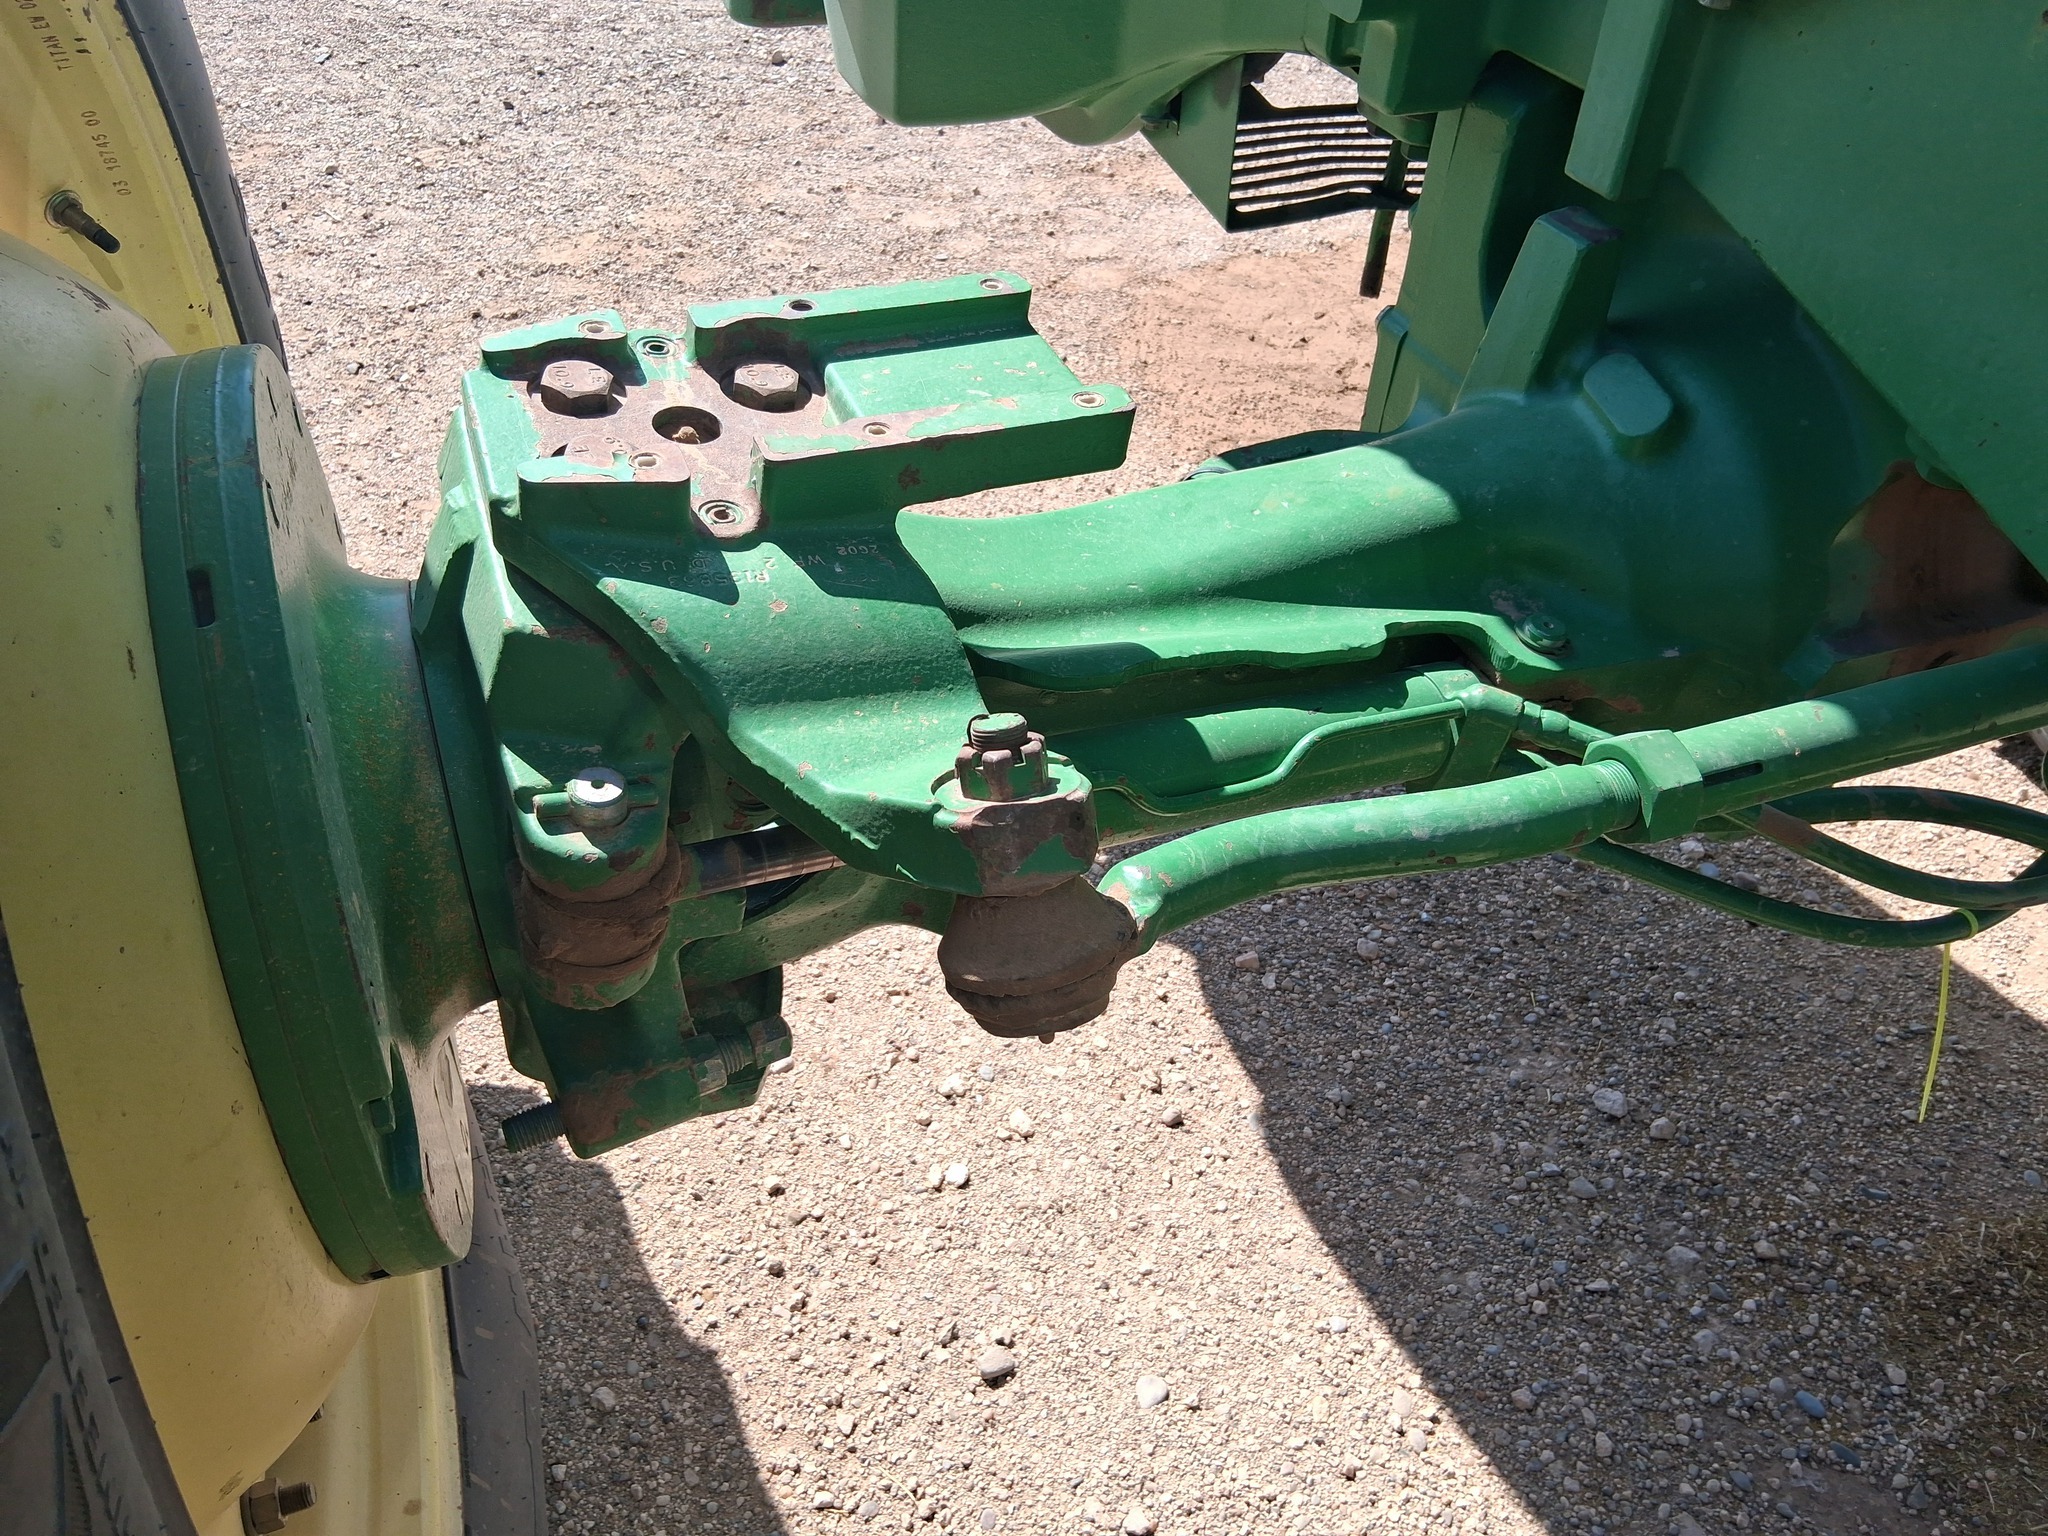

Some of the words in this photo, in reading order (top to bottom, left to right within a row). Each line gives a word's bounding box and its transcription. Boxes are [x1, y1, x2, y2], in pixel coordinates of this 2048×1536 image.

[42, 35, 73, 71] TITAN
[81, 111, 100, 127] 00
[92, 134, 121, 171] 18745
[112, 180, 131, 196] 03
[552, 366, 574, 388] 10.9
